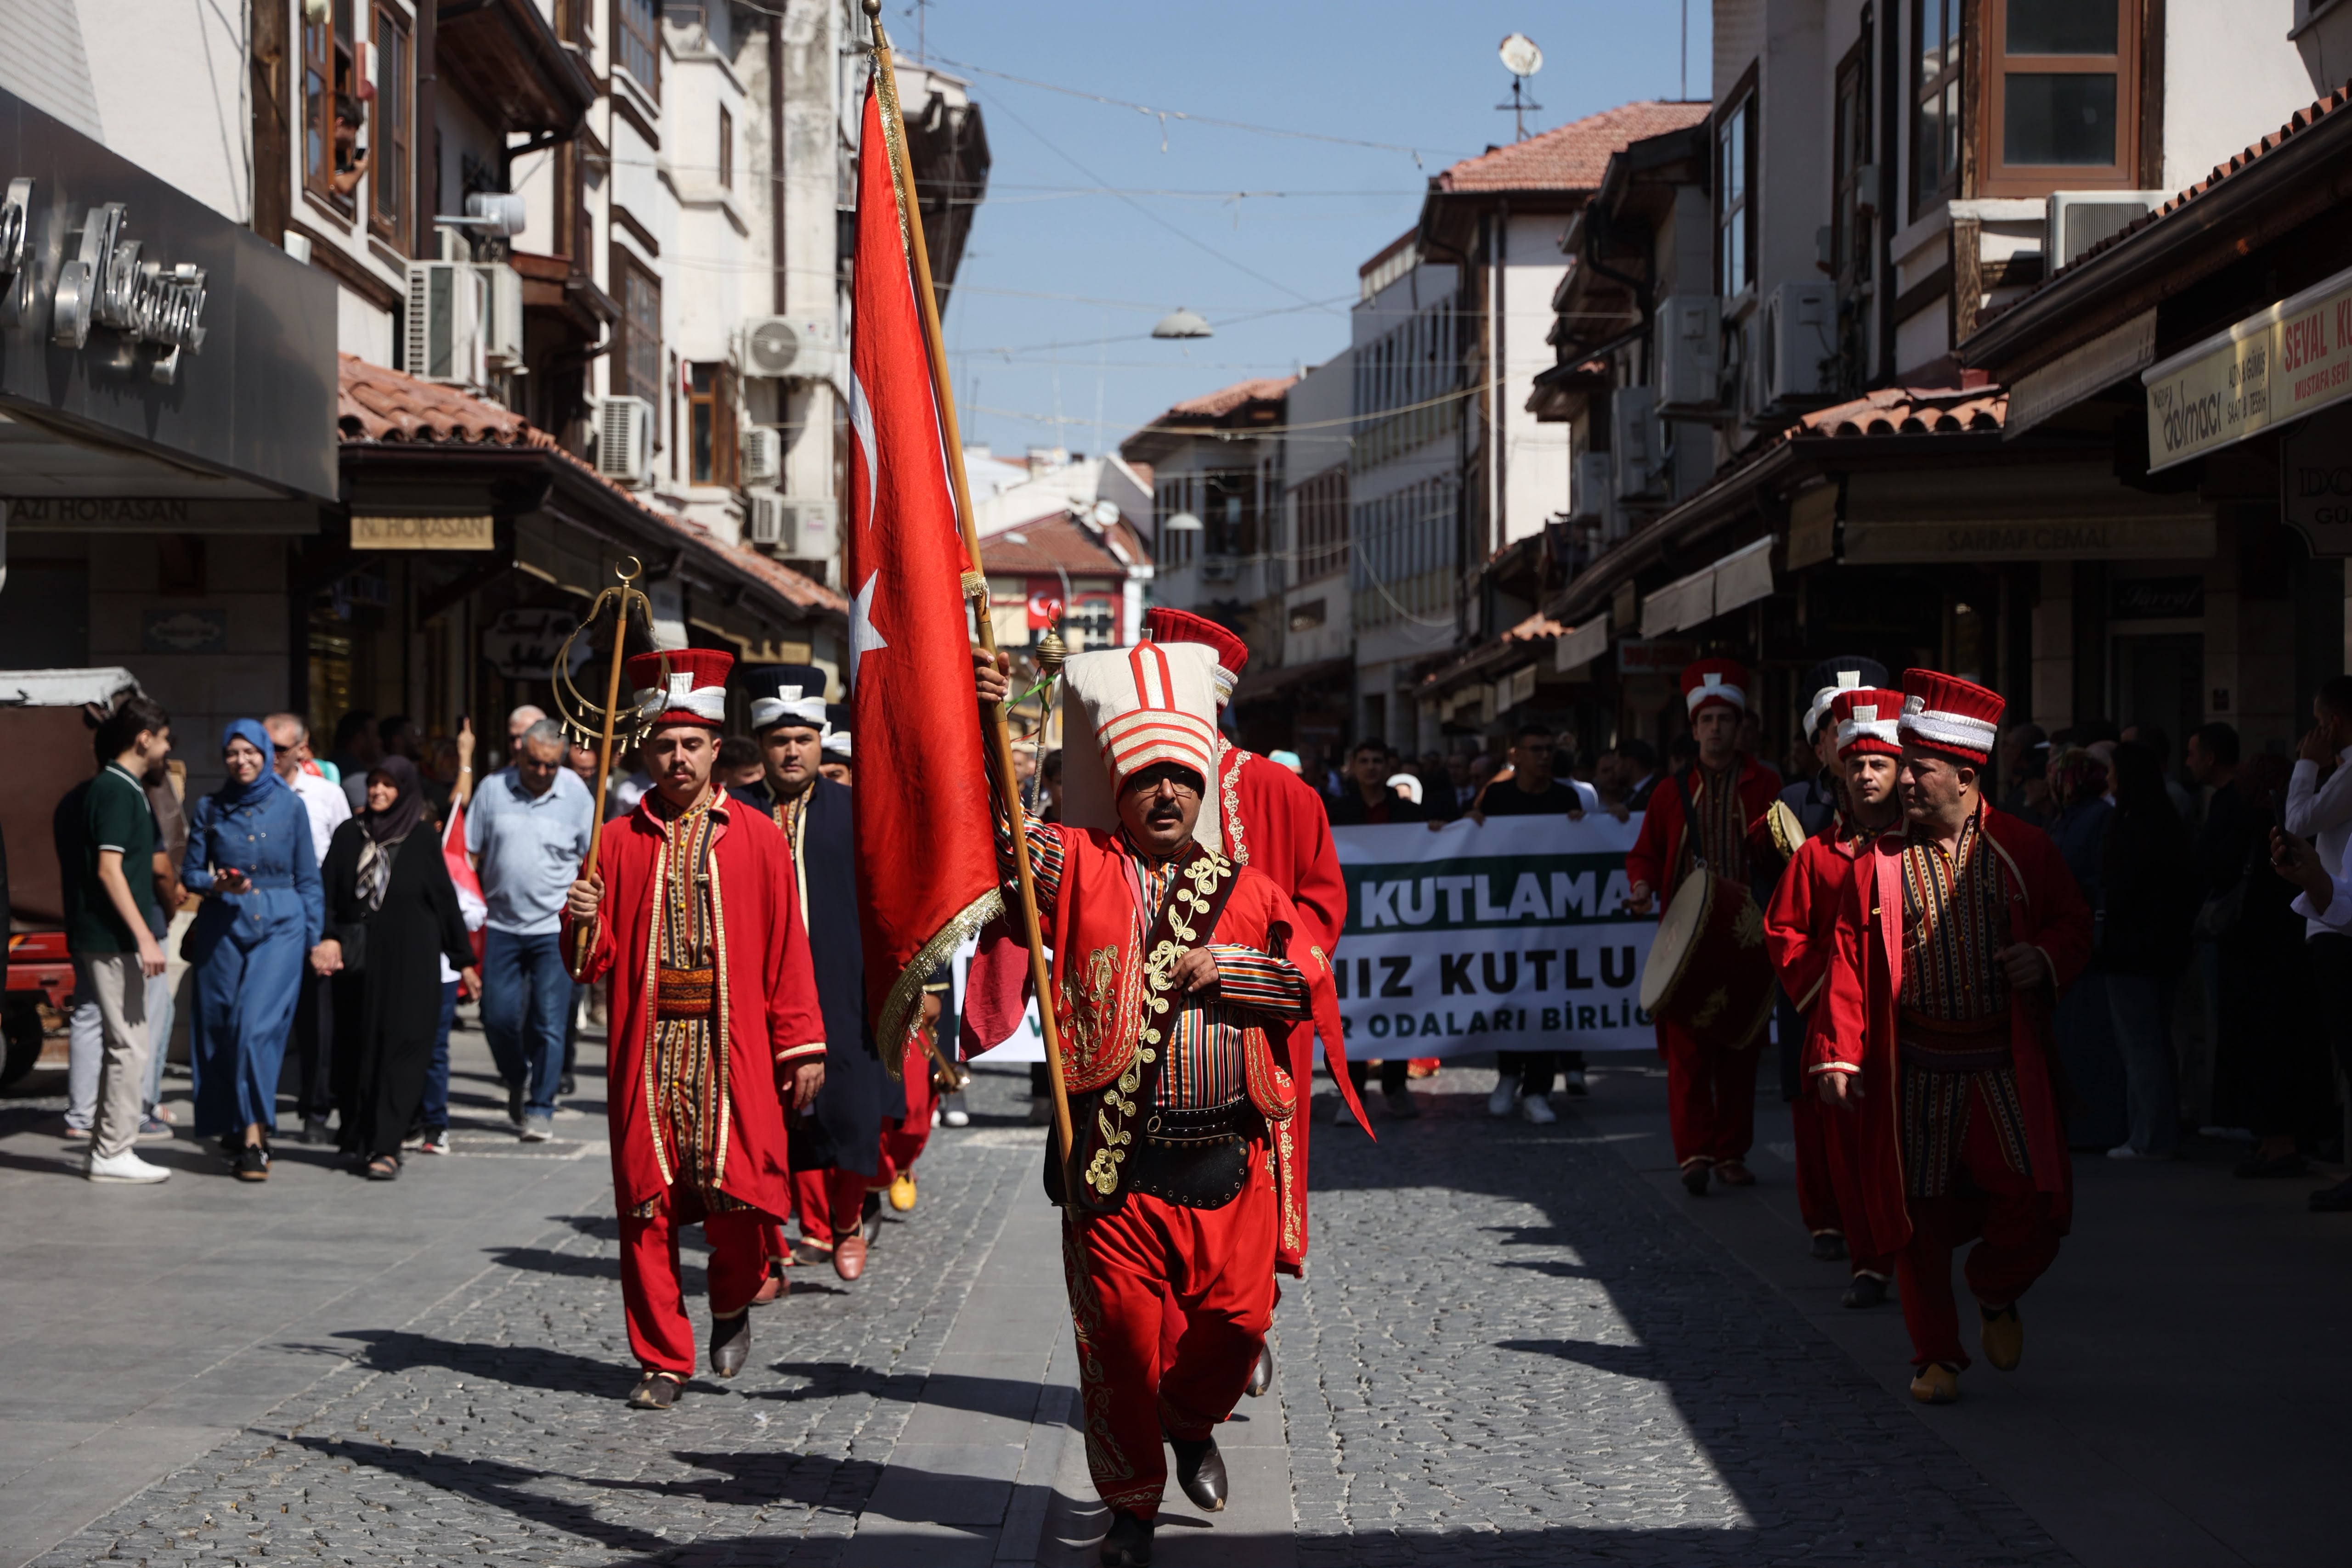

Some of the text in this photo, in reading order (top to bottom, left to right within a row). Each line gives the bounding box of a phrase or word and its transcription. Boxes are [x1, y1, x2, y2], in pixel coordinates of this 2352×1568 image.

[2285, 310, 2328, 373] SEVAL
[2295, 369, 2329, 402] MUSTAFA
[2227, 399, 2241, 425] SAAT
[59, 498, 188, 522] HORASAN
[2314, 504, 2352, 525] GÜ
[387, 517, 485, 538] HORASAN
[1947, 526, 2112, 552] SARRAF CEMAL
[1360, 870, 1661, 928] KUTLAMA
[1441, 946, 1636, 995] KUTLU
[1368, 1009, 1525, 1038] ODALARI
